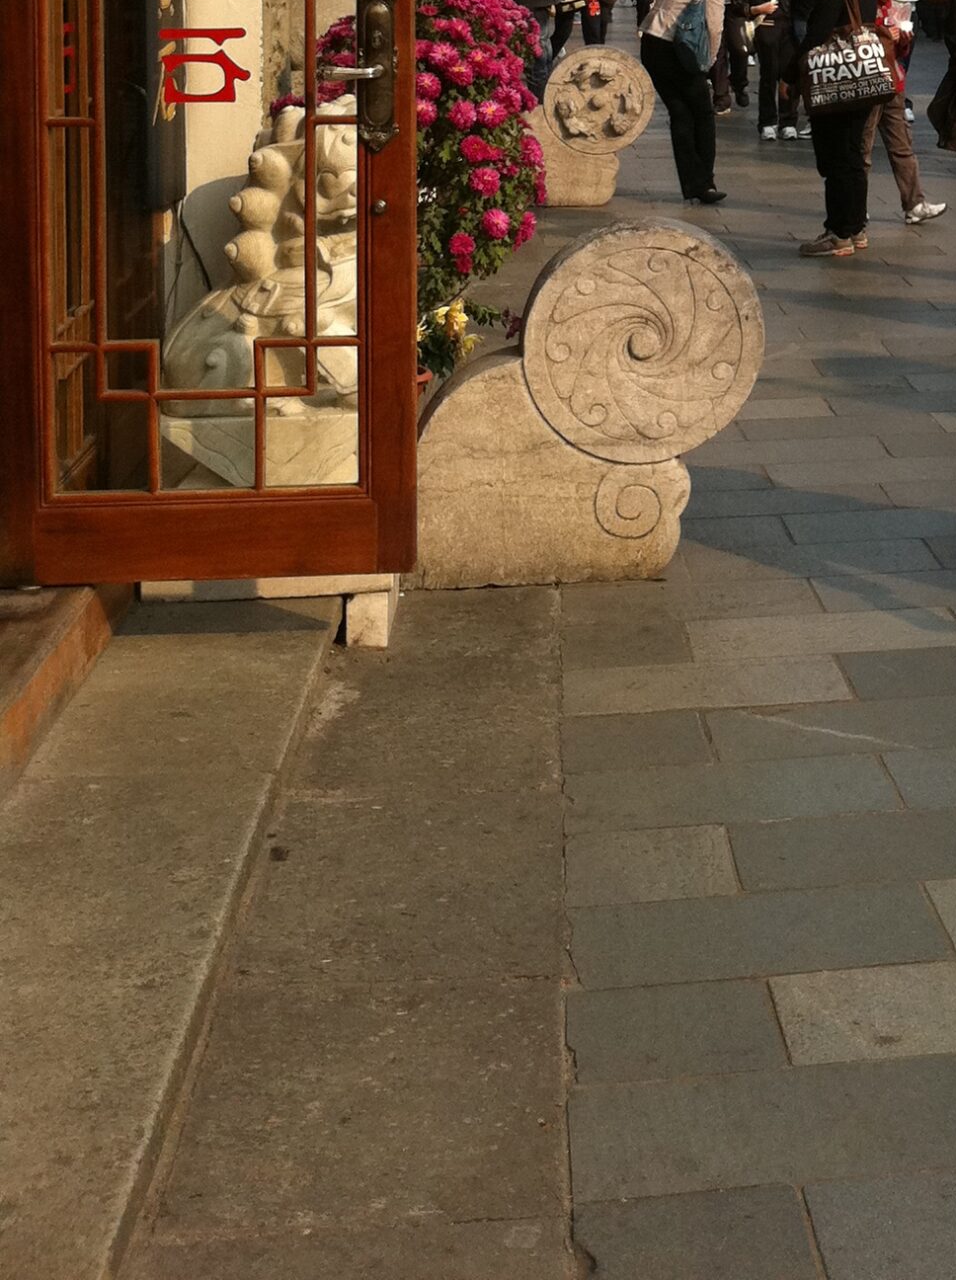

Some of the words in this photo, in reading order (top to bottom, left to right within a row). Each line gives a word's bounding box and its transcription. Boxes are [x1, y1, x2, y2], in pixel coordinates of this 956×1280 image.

[808, 50, 857, 70] WING
[857, 42, 885, 60] ON
[808, 57, 890, 85] TRAVEL
[811, 94, 838, 105] WING
[840, 90, 856, 99] ON
[857, 82, 895, 96] TRAVEL
